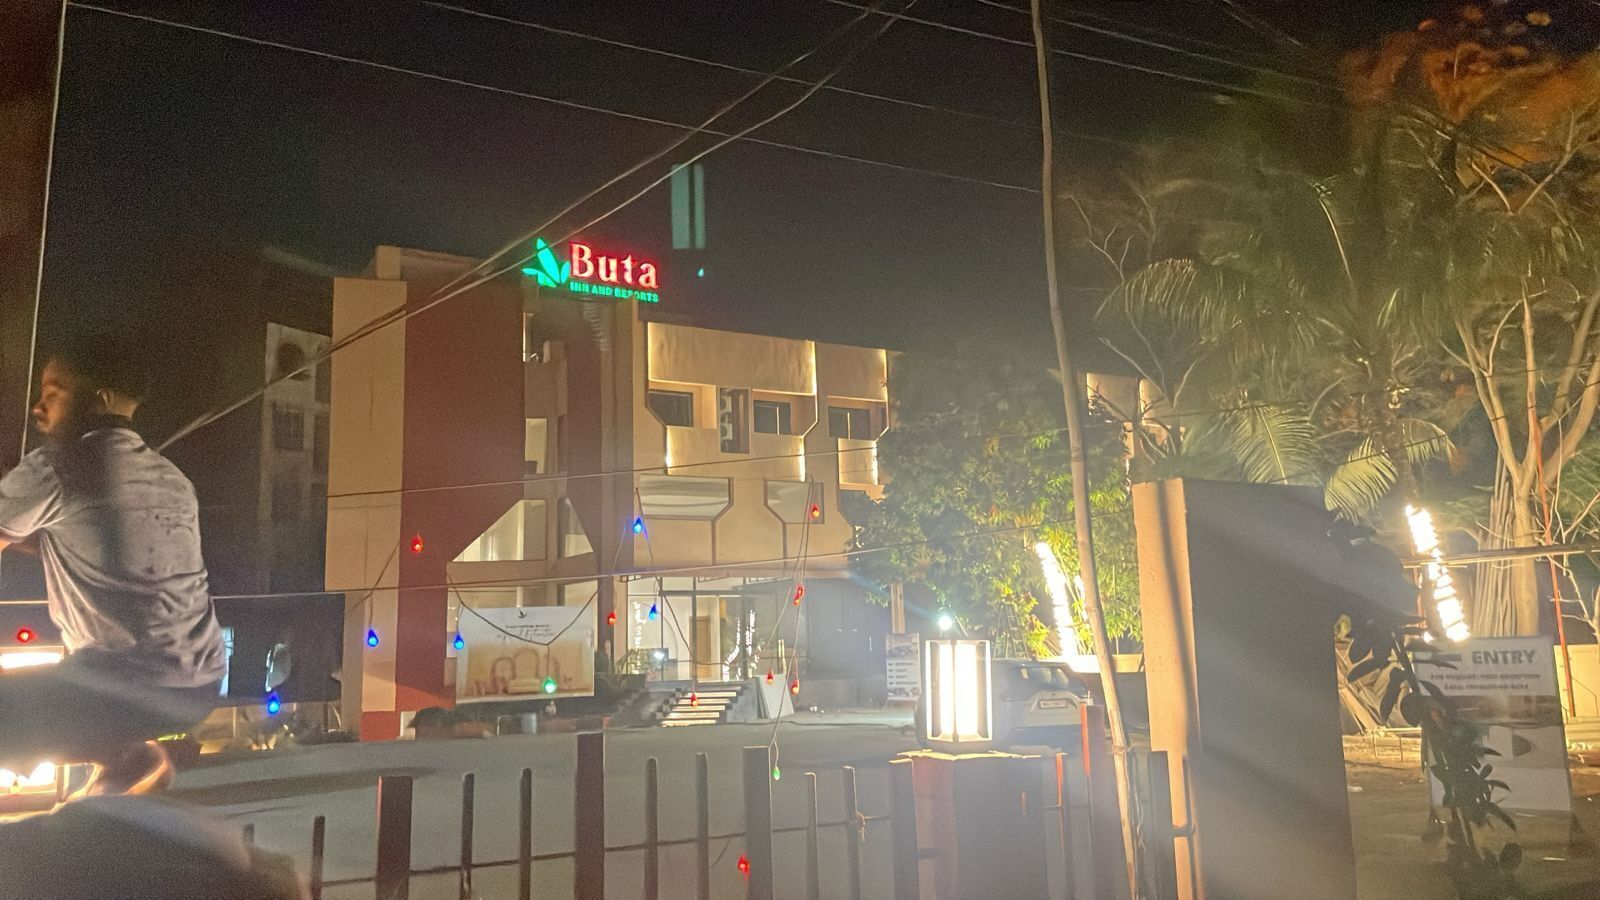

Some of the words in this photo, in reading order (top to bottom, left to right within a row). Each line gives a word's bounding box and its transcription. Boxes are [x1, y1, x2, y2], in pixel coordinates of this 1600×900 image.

[570, 243, 659, 289] Buta
[570, 281, 589, 293] INN
[591, 285, 613, 296] AND
[614, 287, 659, 303] RESORTS
[1472, 649, 1536, 665] ENTRY
